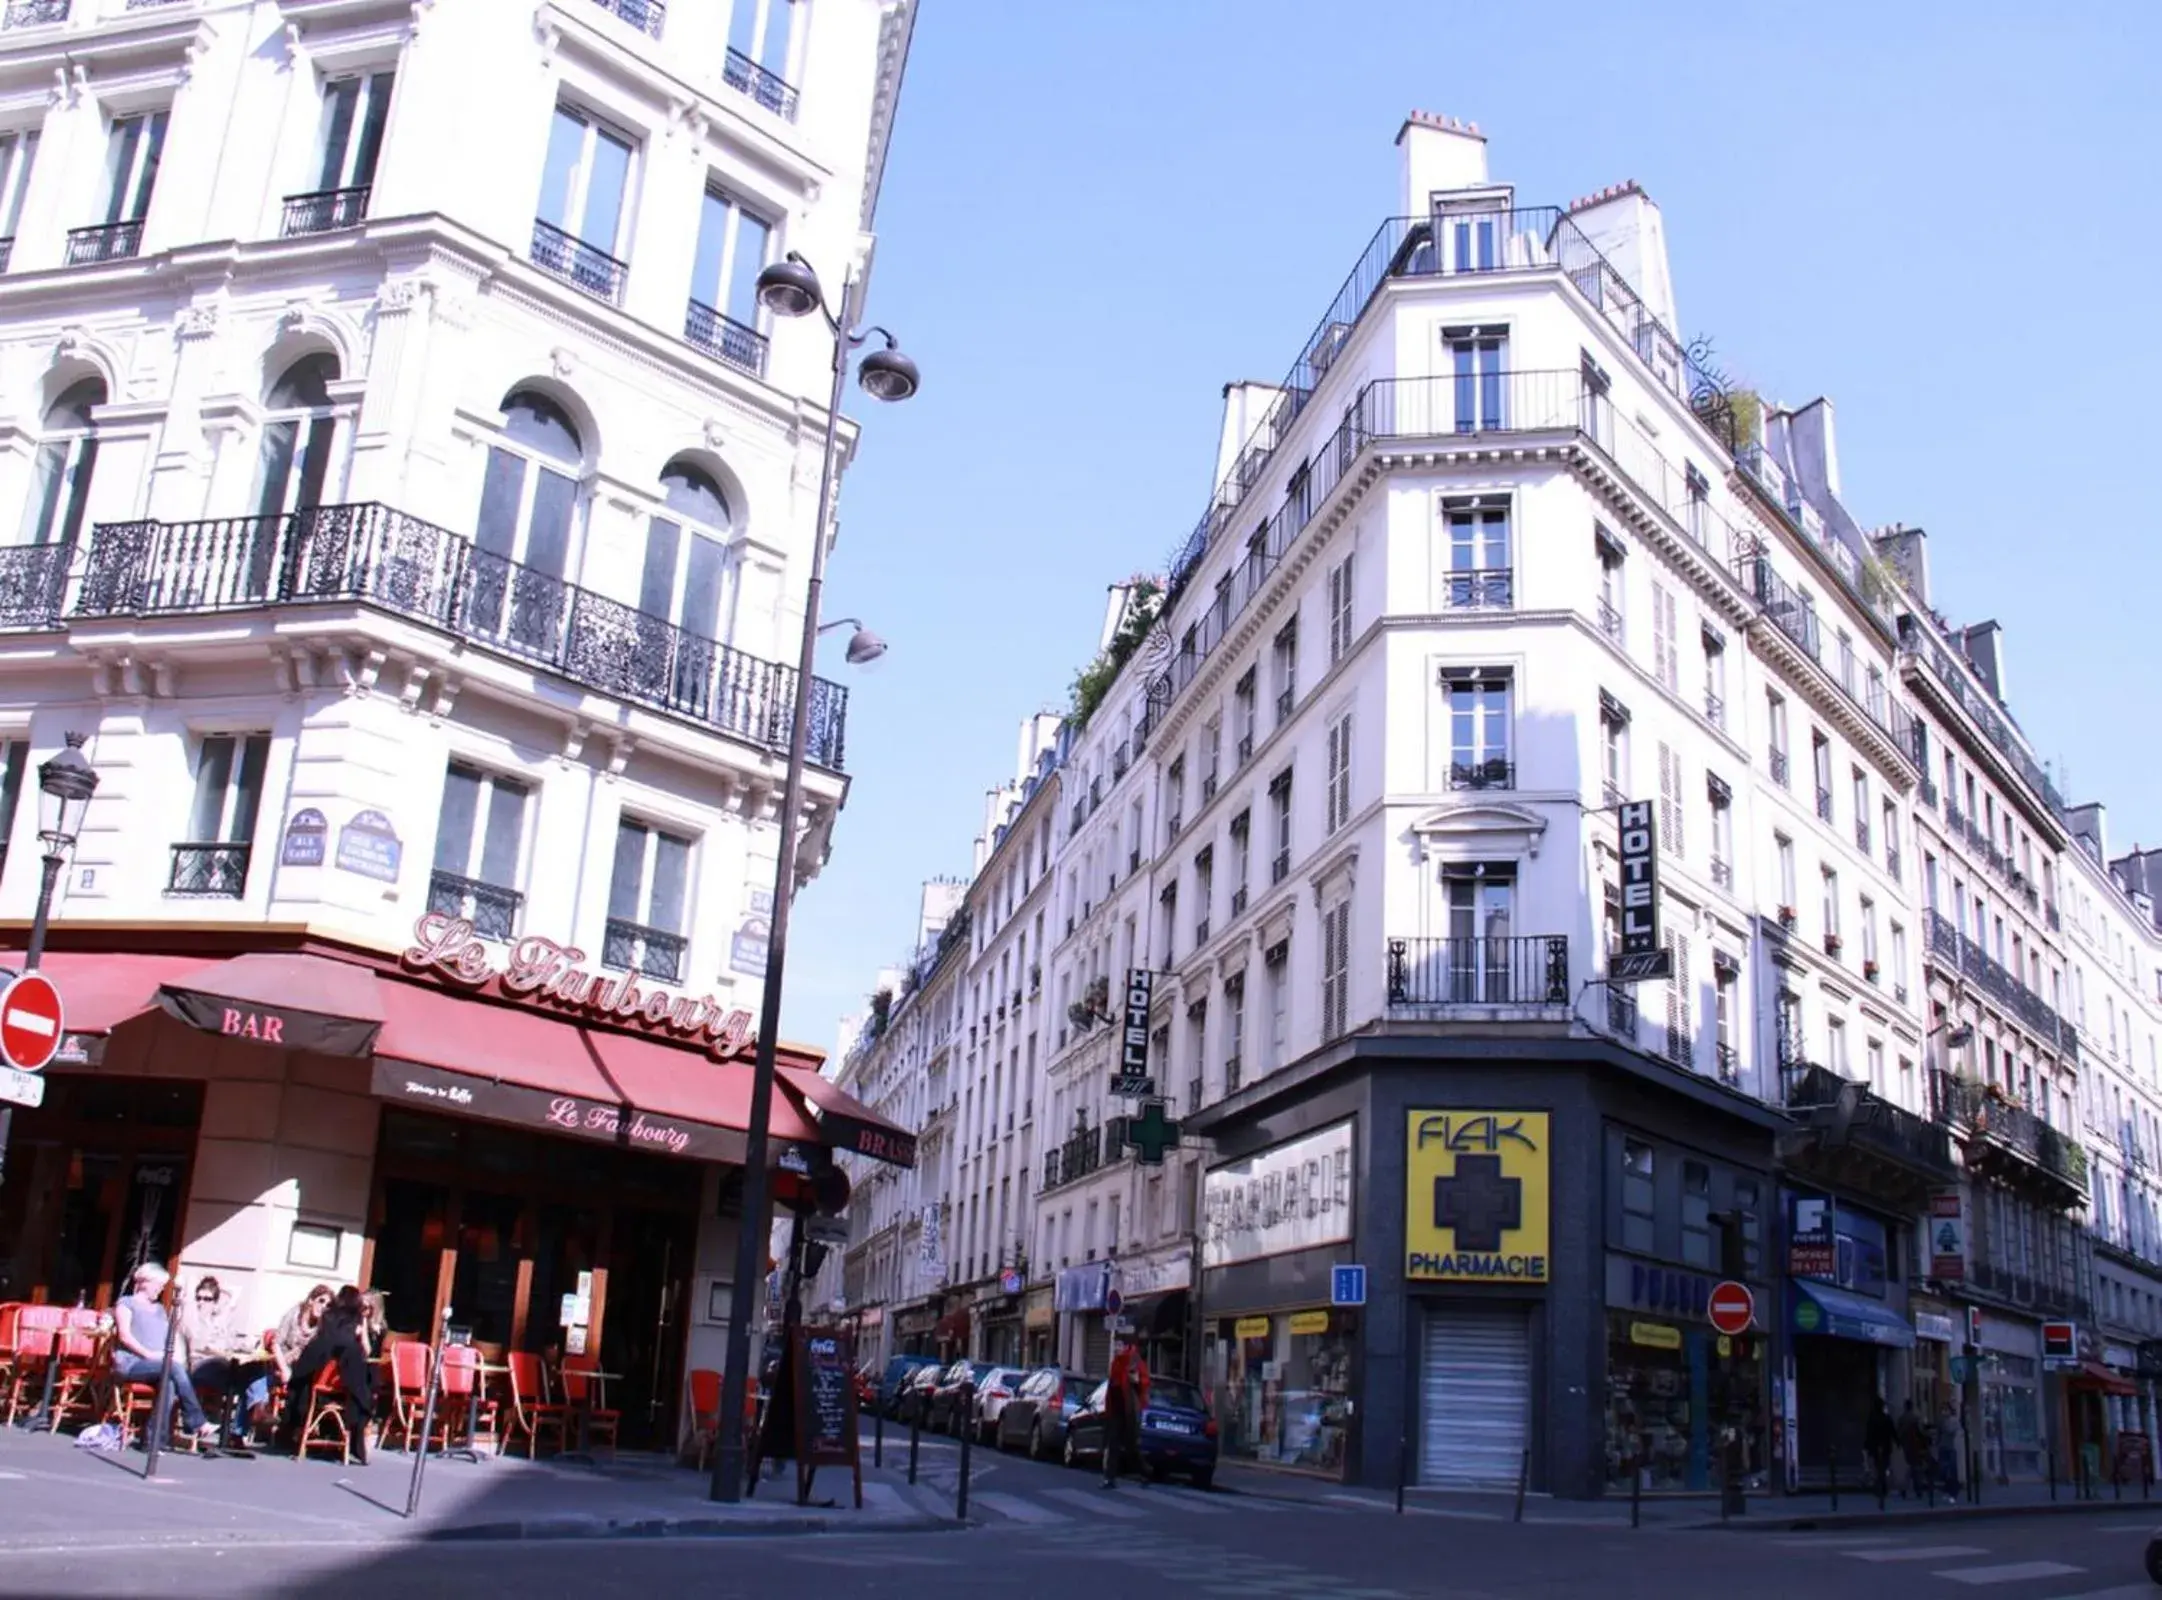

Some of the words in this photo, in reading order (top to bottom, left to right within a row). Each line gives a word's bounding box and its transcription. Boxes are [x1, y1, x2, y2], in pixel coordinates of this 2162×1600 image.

[1623, 803, 1651, 935] HOTEL
[403, 912, 494, 984] Le
[501, 937, 758, 1058] Faubourg
[221, 1007, 284, 1043] BAR
[1125, 970, 1149, 1065] HOTEL
[546, 1097, 579, 1127] Le
[584, 1107, 691, 1152] Faubourg
[1417, 1116, 1536, 1152] FLAK
[1409, 1253, 1545, 1278] PHARMACIE
